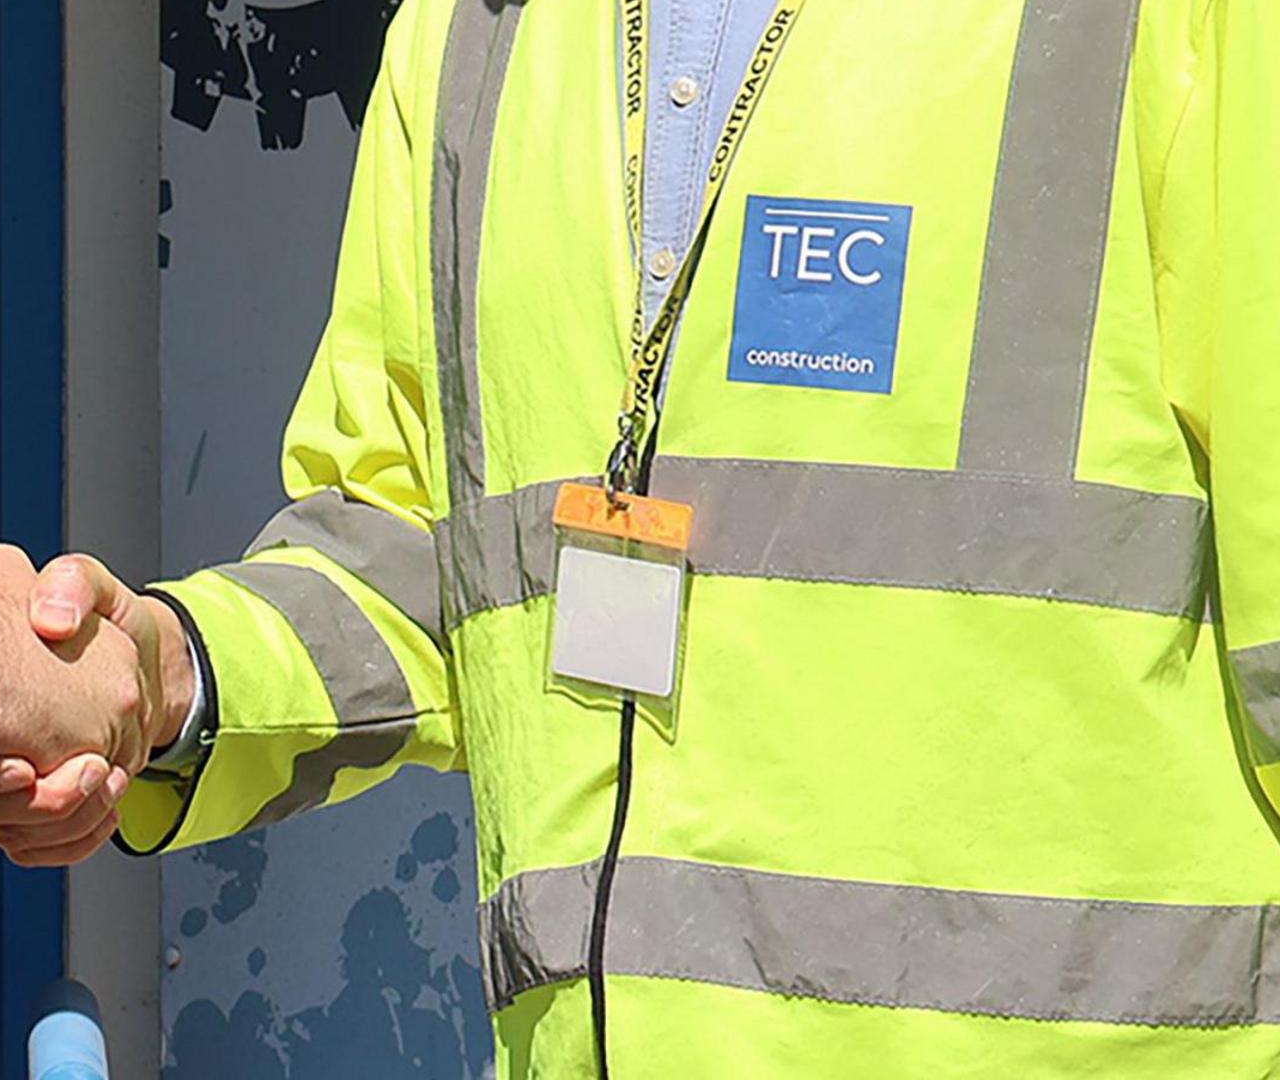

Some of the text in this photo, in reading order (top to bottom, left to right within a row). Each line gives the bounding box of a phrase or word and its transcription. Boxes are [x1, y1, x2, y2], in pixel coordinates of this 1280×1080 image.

[708, 8, 795, 183] CONTRACTOR
[763, 223, 885, 285] TEC
[746, 348, 875, 375] construction
